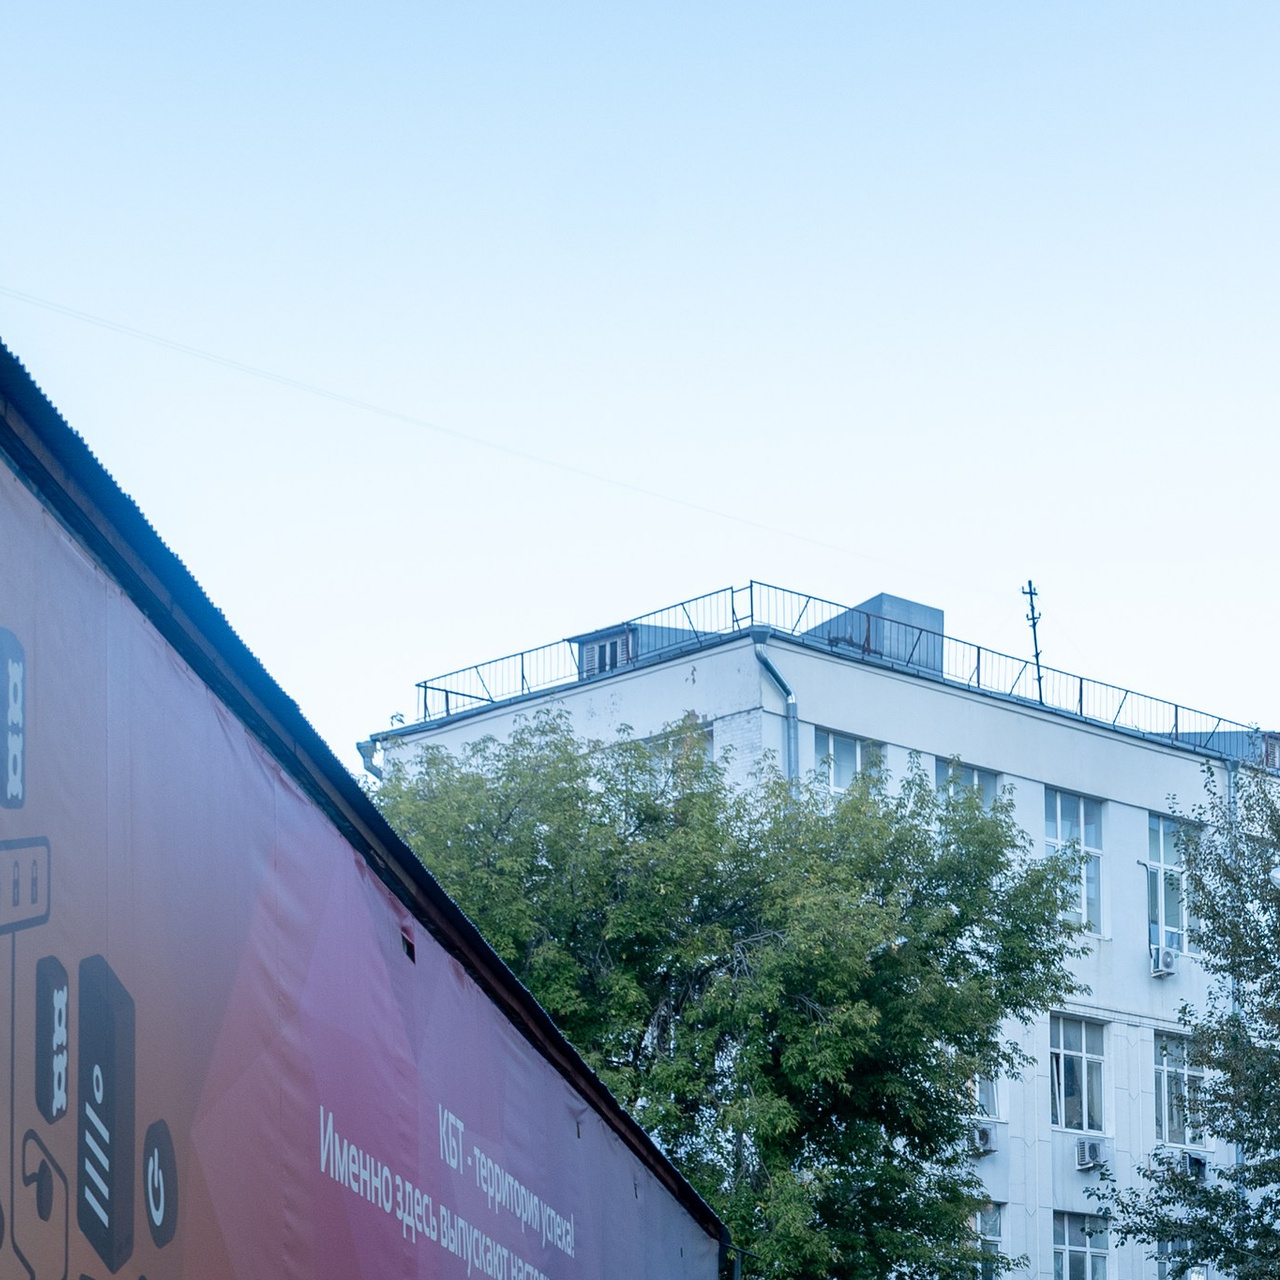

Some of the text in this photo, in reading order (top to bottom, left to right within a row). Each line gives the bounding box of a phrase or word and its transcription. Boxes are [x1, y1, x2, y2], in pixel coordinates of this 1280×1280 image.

[320, 1105, 393, 1214] Именно
[395, 1174, 438, 1244] здесь
[438, 1103, 465, 1175] КБТ
[473, 1146, 540, 1234] территория
[540, 1200, 575, 1259] успеха!
